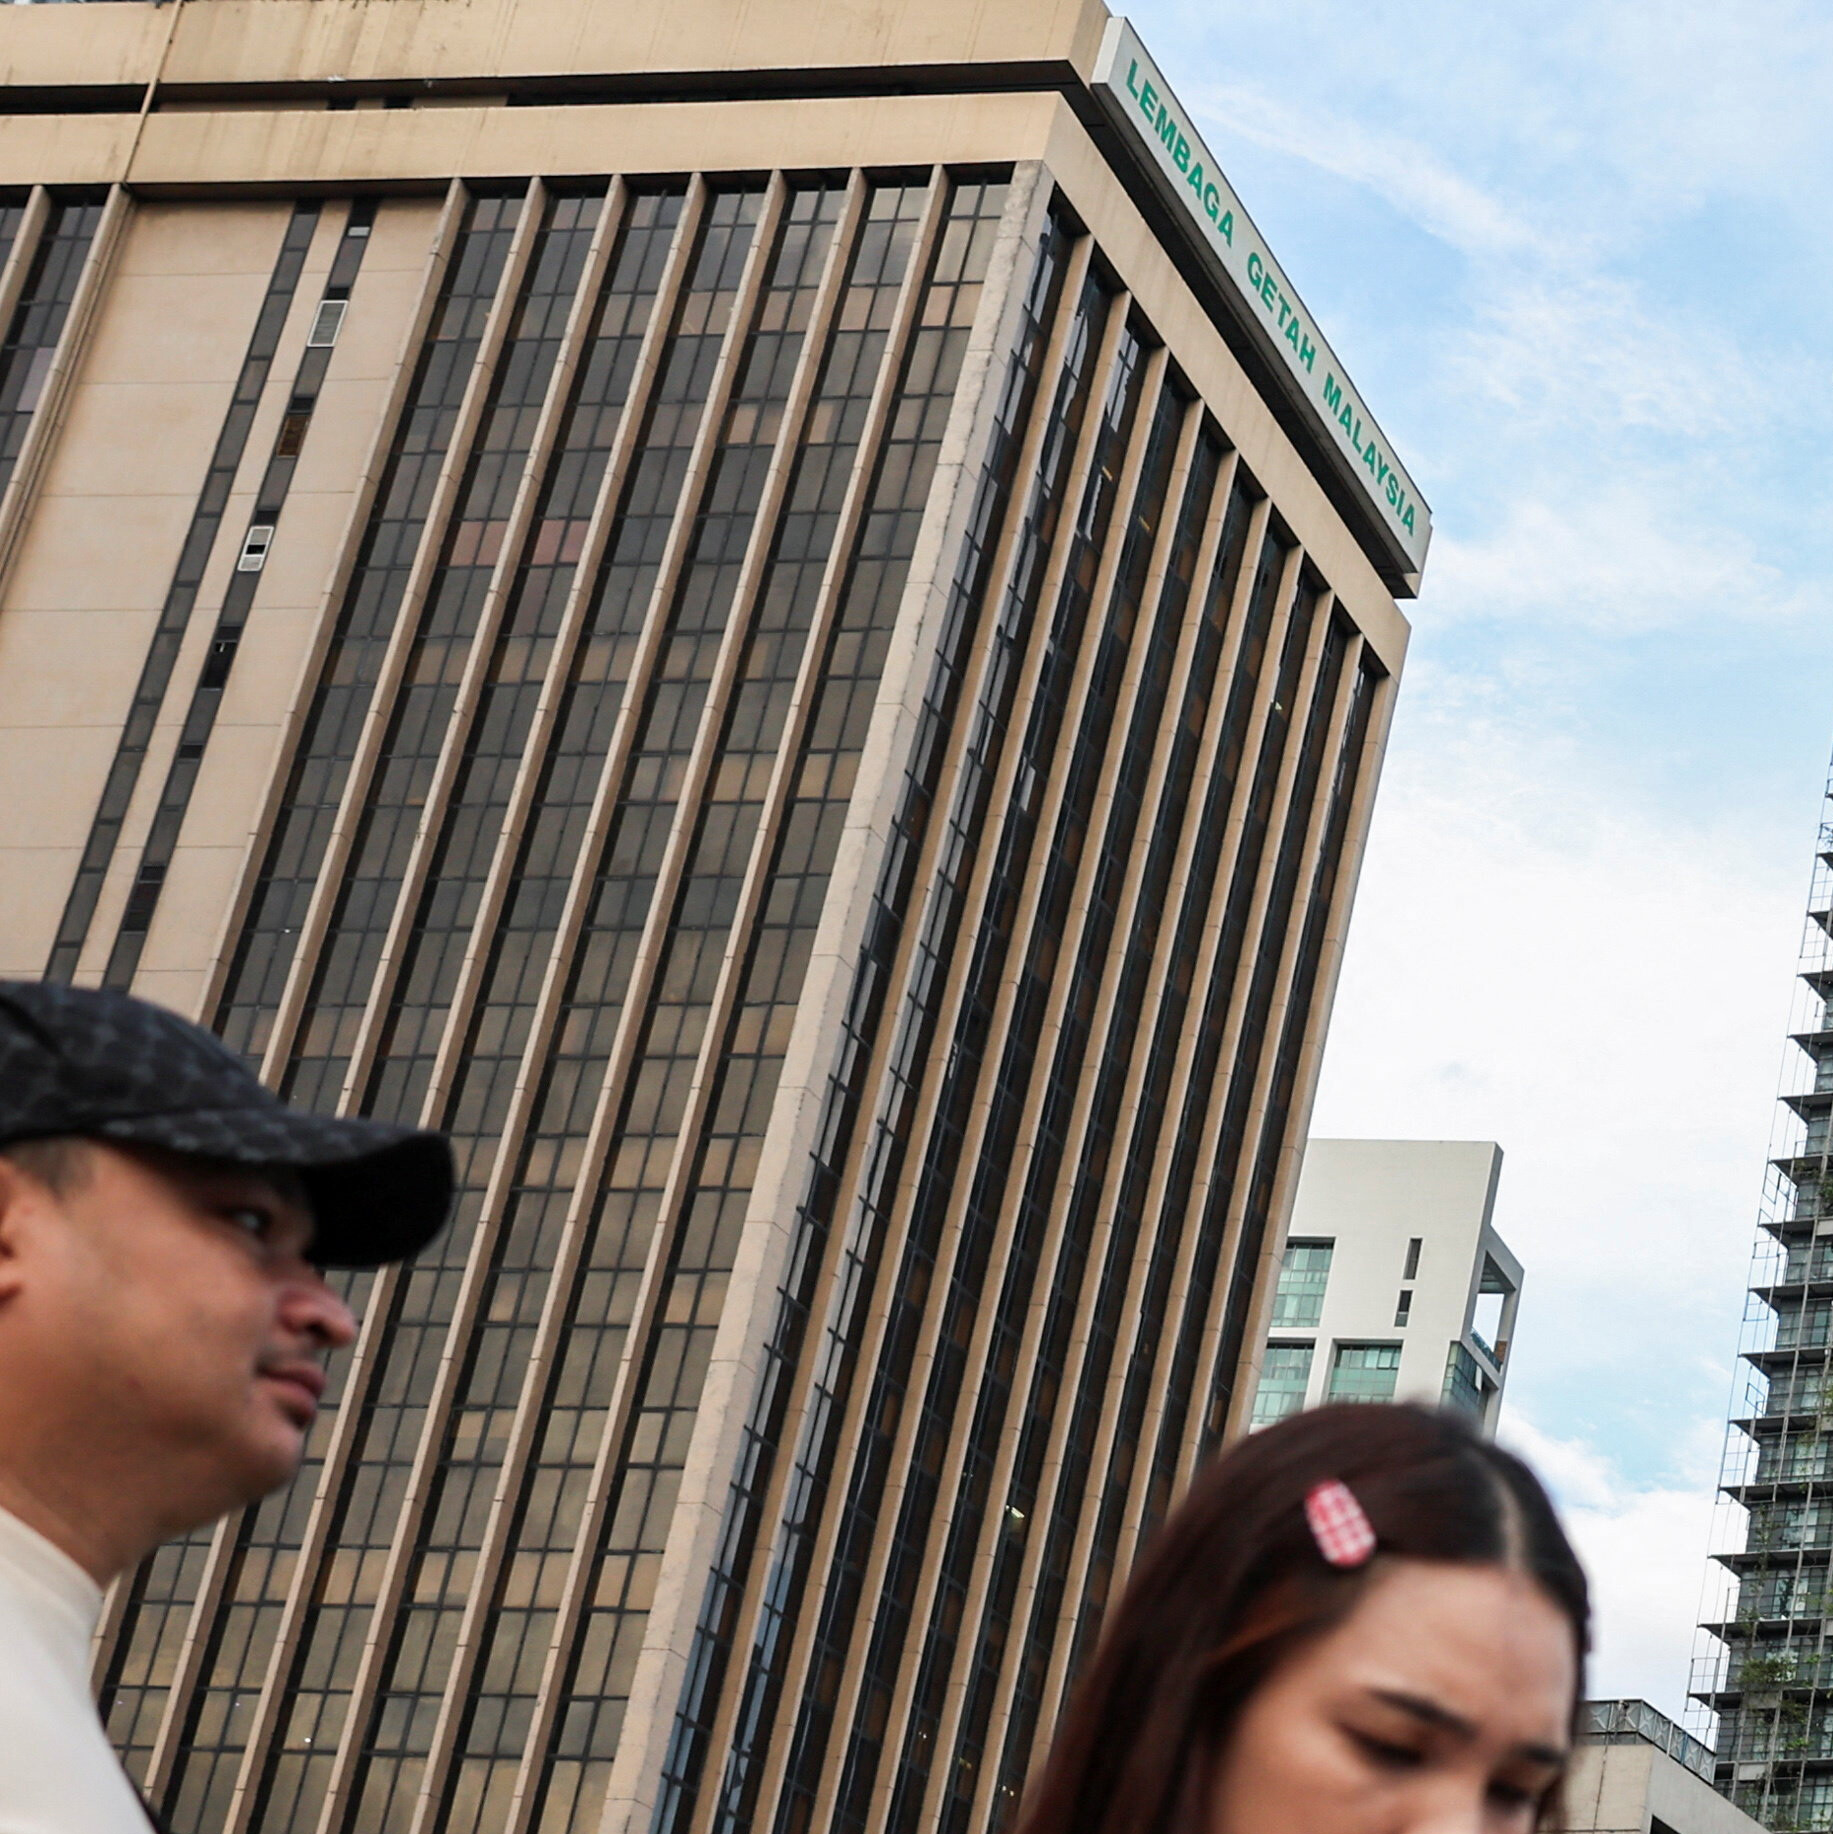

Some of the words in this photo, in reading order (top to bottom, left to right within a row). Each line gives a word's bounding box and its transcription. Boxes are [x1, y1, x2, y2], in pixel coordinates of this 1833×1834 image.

[1126, 57, 1235, 248] LEMBAGA
[1247, 252, 1317, 374] GETAH
[1323, 371, 1417, 537] MALAYSIA
